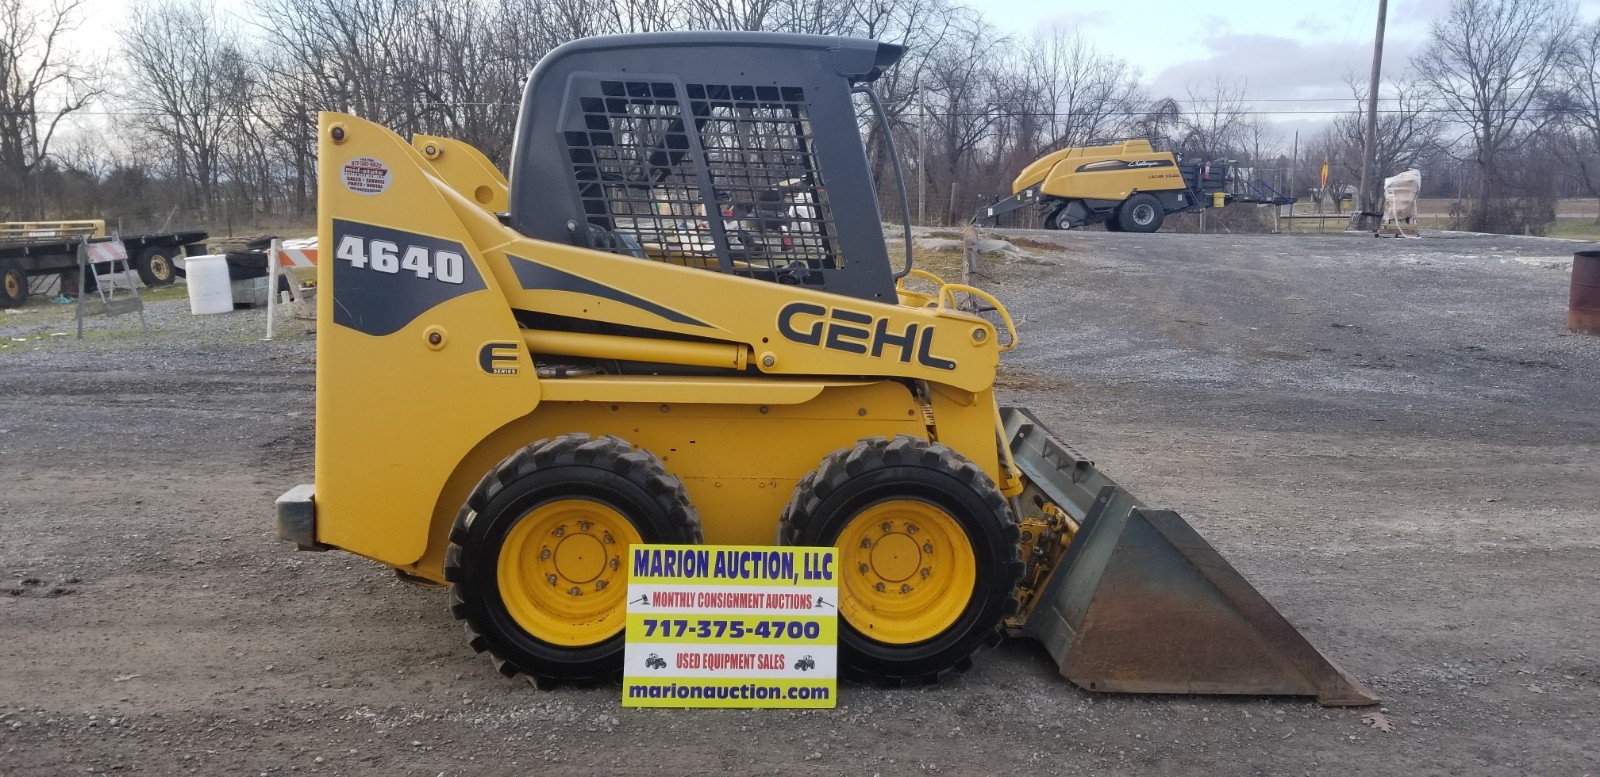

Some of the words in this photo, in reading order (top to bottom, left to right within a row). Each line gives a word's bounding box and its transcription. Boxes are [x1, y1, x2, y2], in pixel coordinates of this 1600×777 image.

[336, 234, 464, 284] 4640
[777, 302, 957, 371] GEHL
[479, 343, 518, 374] E
[633, 549, 709, 579] MARION
[714, 550, 799, 585] AUCTION,
[804, 552, 833, 580] LLC
[652, 591, 696, 608] MONTHLY
[697, 592, 765, 609] CONSIGNMENT
[766, 594, 812, 609] AUCTIONS
[643, 620, 820, 639] 717-375-4700
[676, 653, 700, 669] USED
[702, 653, 756, 670] EQUIPMENT
[757, 654, 785, 670] SALES
[629, 683, 829, 700] marionauction.com
